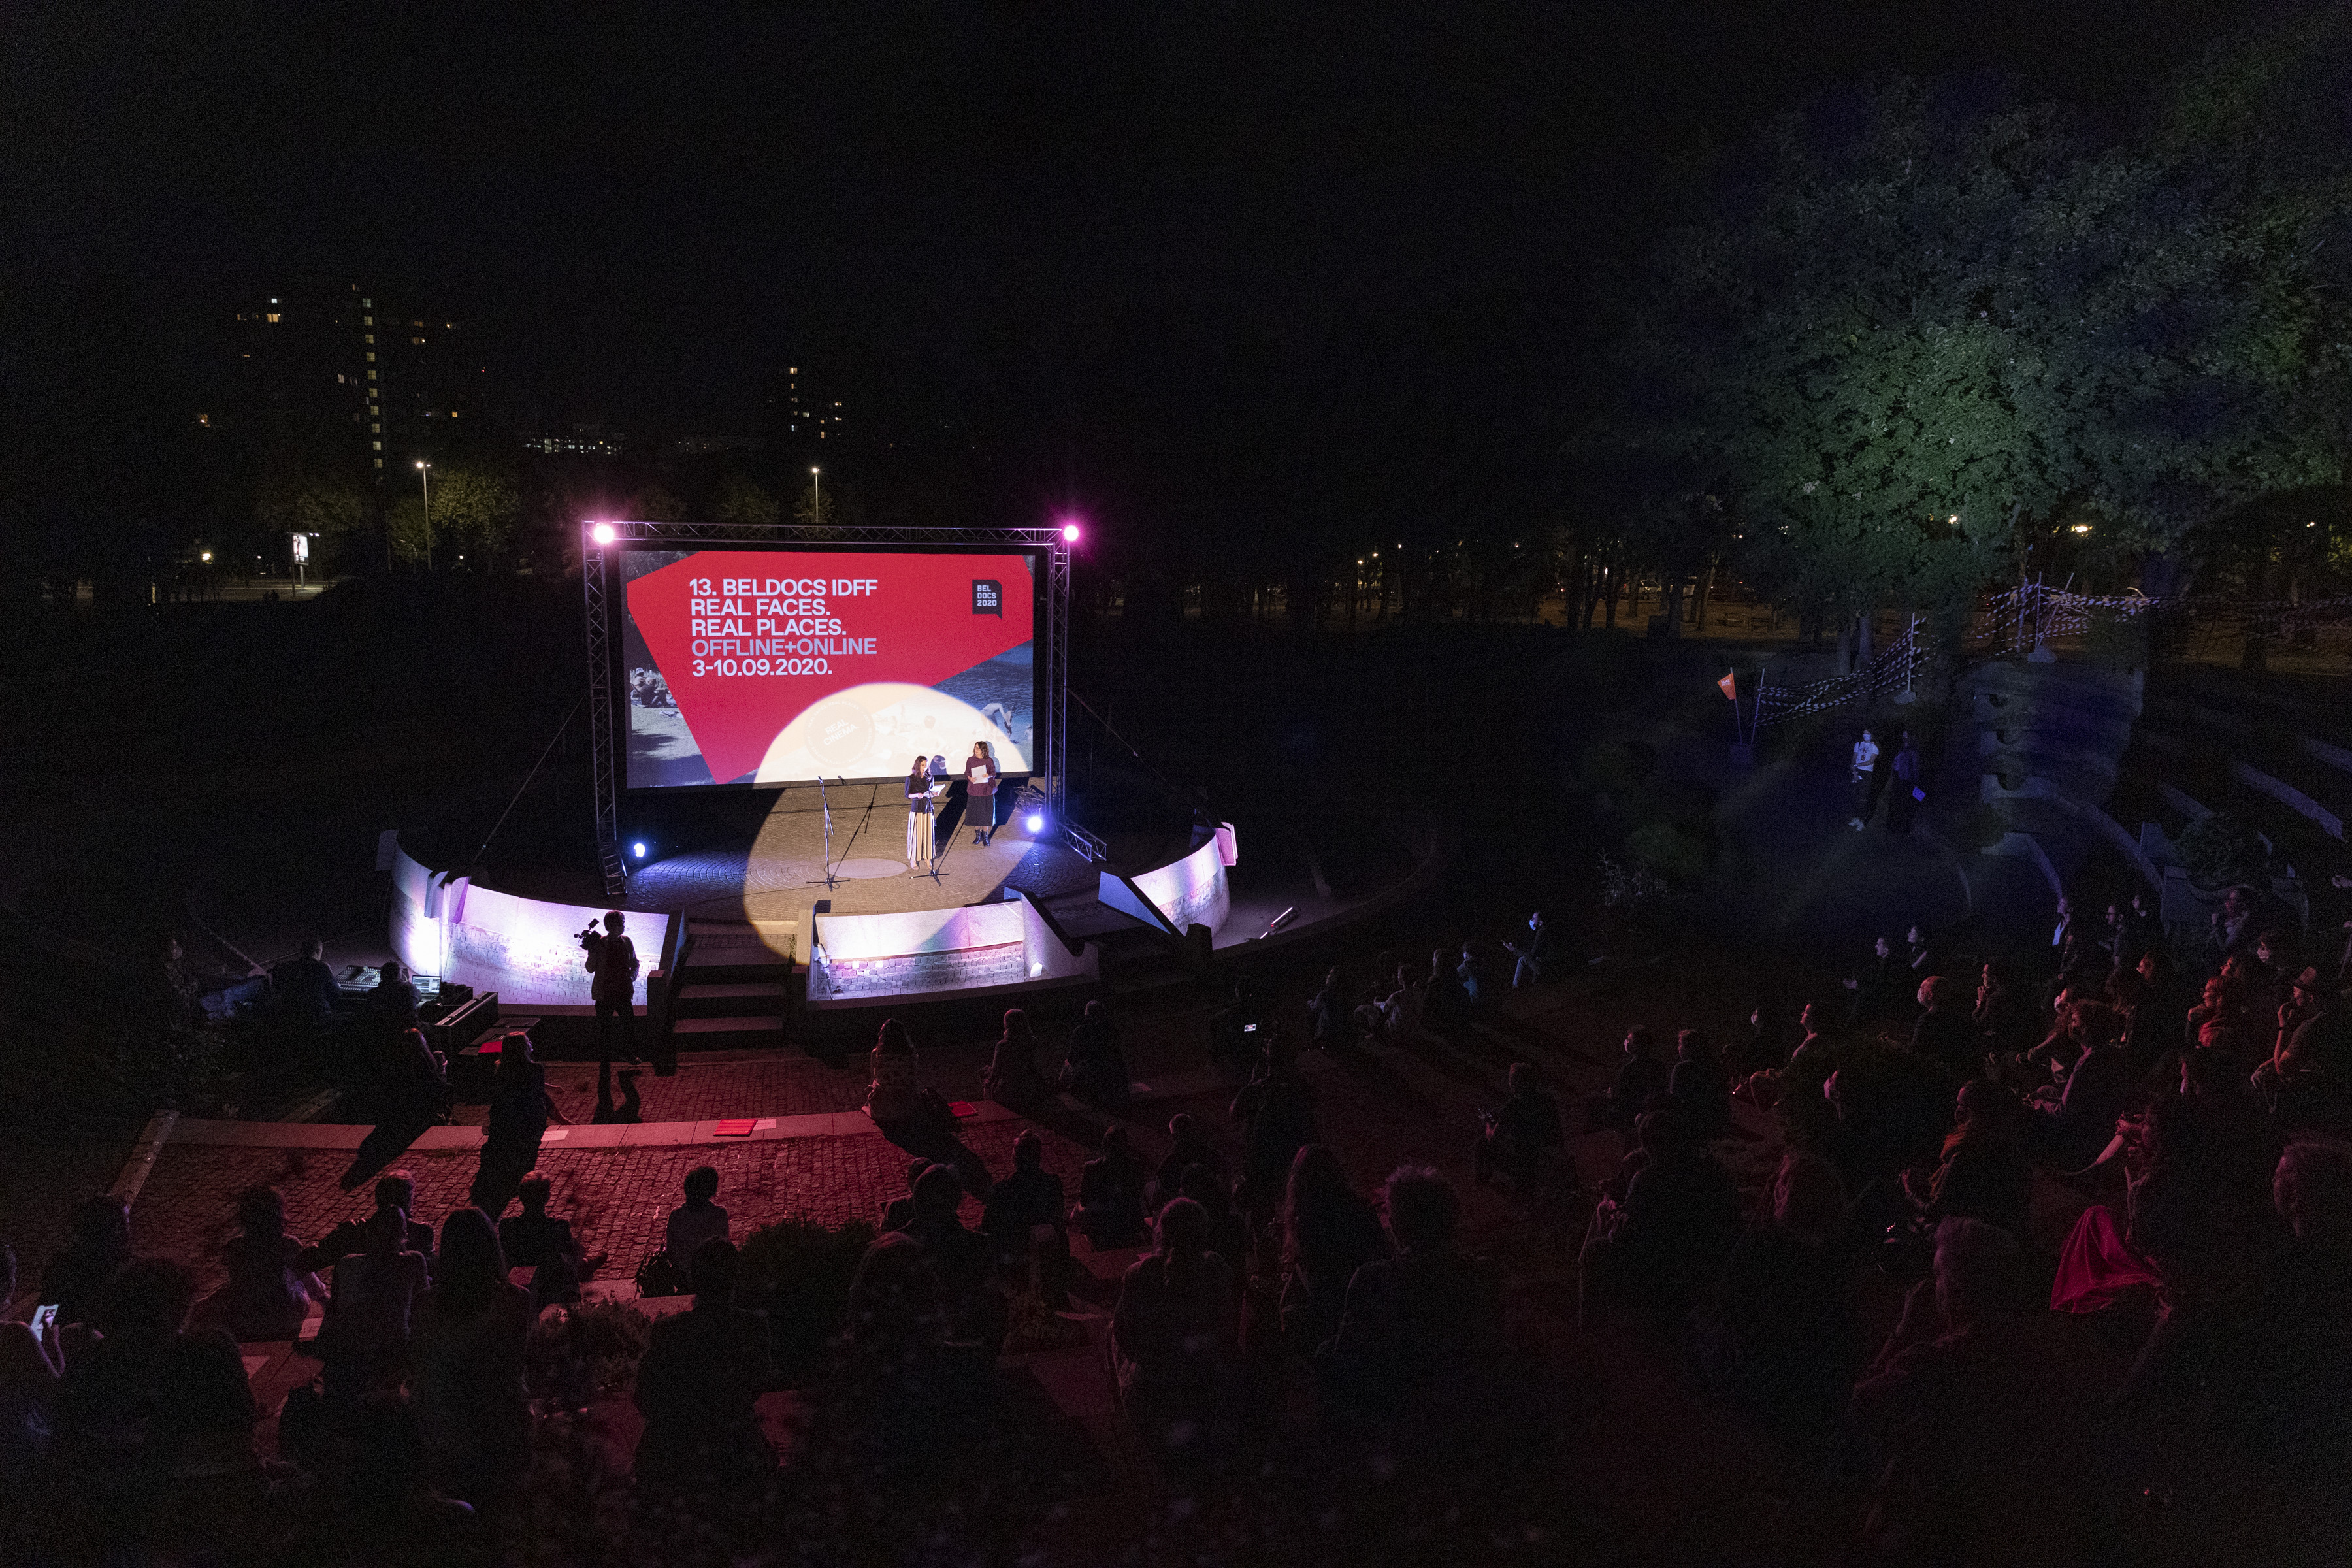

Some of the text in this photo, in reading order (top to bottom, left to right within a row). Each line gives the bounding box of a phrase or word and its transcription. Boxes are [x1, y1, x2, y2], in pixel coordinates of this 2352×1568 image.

[689, 578, 878, 596] 13. BELDOCS IDFF
[691, 598, 831, 617] REAL FACES.
[692, 619, 847, 636] REAL PLACES.
[692, 638, 877, 657] OFFLINE+ONLINE
[693, 658, 832, 677] 3-10.09.2020.
[825, 719, 849, 735] REAL
